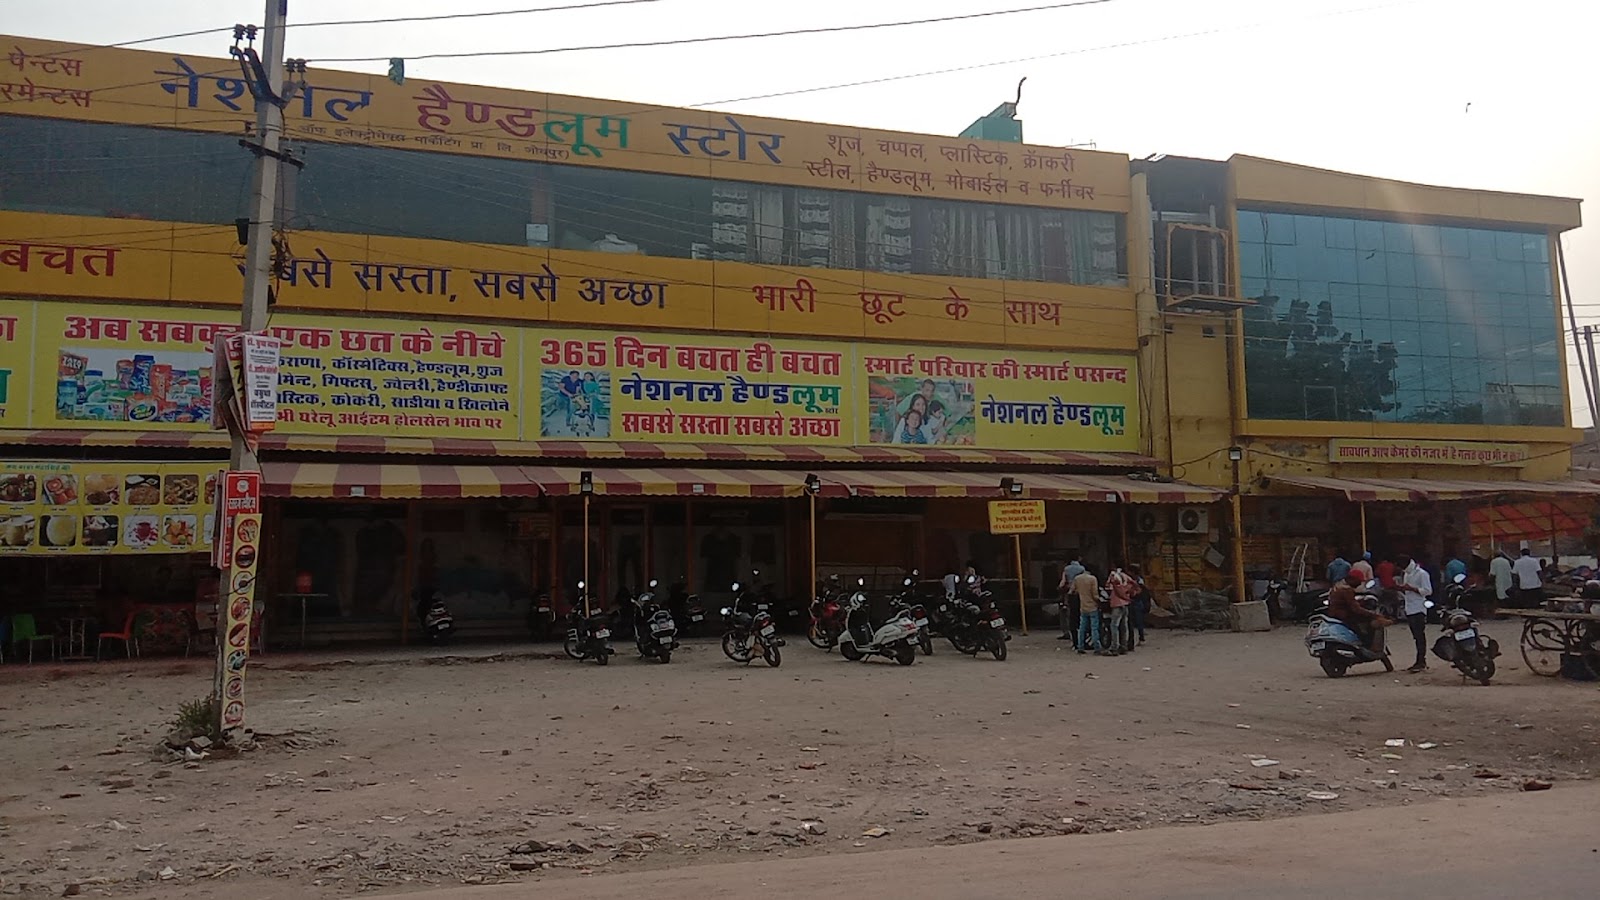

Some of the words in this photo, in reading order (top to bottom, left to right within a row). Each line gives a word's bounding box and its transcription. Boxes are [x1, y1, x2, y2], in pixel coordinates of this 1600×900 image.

[0, 77, 93, 108] रमेन्टस
[411, 84, 632, 158] हैण्डलूम
[662, 115, 786, 164] स्टोर
[938, 143, 1013, 170] प्लास्टिक,
[803, 158, 855, 184] स्टील,
[866, 160, 935, 192] हैण्डलूम,
[945, 168, 1009, 195] मोबाईल
[1017, 180, 1031, 196] व
[1039, 178, 1096, 201] फर्नीचर
[0, 242, 122, 277] बचत
[237, 248, 333, 289] बसे
[350, 262, 458, 302] सस्ता,
[470, 264, 561, 302] सबसे
[577, 276, 669, 309] अच्छा
[752, 279, 818, 314] भारी
[857, 290, 907, 324] छूट
[943, 286, 971, 321] के
[1005, 300, 1063, 326] साथ
[64, 315, 132, 342] अब
[271, 326, 332, 349] एक
[340, 327, 394, 353] छत
[401, 327, 434, 355] के
[441, 325, 506, 359] नीचे
[540, 339, 607, 366] 365
[614, 336, 671, 369] दिन
[675, 346, 741, 372] बचत
[745, 342, 776, 373] ही
[782, 350, 843, 376] बचत
[864, 353, 915, 377] स्मार्ट
[919, 355, 988, 379] परिवार
[991, 357, 1019, 380] की
[1023, 360, 1071, 383] स्मार्ट
[1074, 366, 1128, 384] पसन्द
[444, 399, 455, 410] व
[619, 372, 727, 402] नेशनल
[727, 375, 843, 413] हैण्डलूम
[394, 412, 450, 428] होलसेल
[454, 416, 482, 429] भाव
[484, 417, 503, 429] पर
[622, 408, 675, 433] सबसे
[679, 414, 732, 436] सस्ता
[734, 410, 785, 437] सबसे
[789, 414, 842, 437] अच्छा
[981, 394, 1049, 426] नेशनल
[1052, 396, 1127, 436] हैण्डलूम
